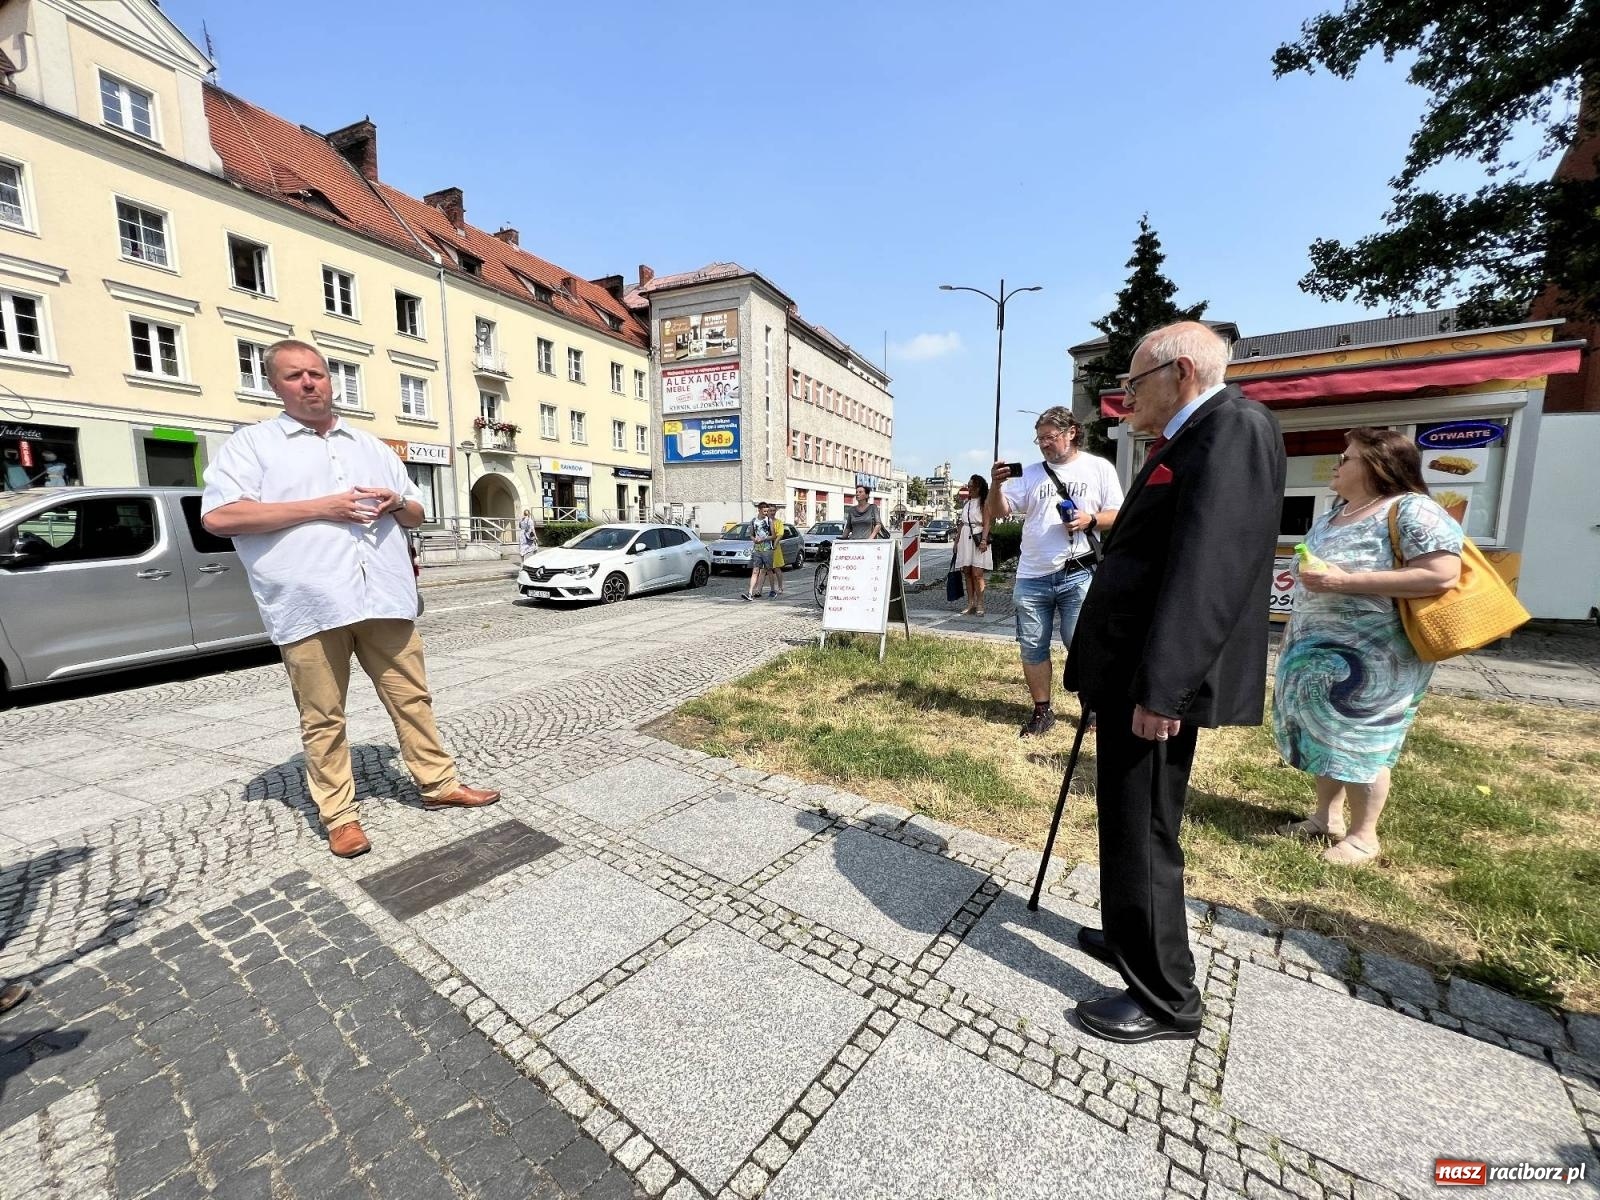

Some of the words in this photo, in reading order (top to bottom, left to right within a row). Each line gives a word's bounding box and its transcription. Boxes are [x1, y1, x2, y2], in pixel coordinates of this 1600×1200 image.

[666, 371, 736, 386] ALEXANDER
[666, 385, 691, 394] MEBLE
[705, 434, 724, 445] 348
[724, 436, 731, 444] zł
[1429, 429, 1491, 441] OTWARTE
[409, 446, 447, 459] SZYCIE
[701, 448, 734, 456] castorama
[560, 463, 583, 472] RAINBOW
